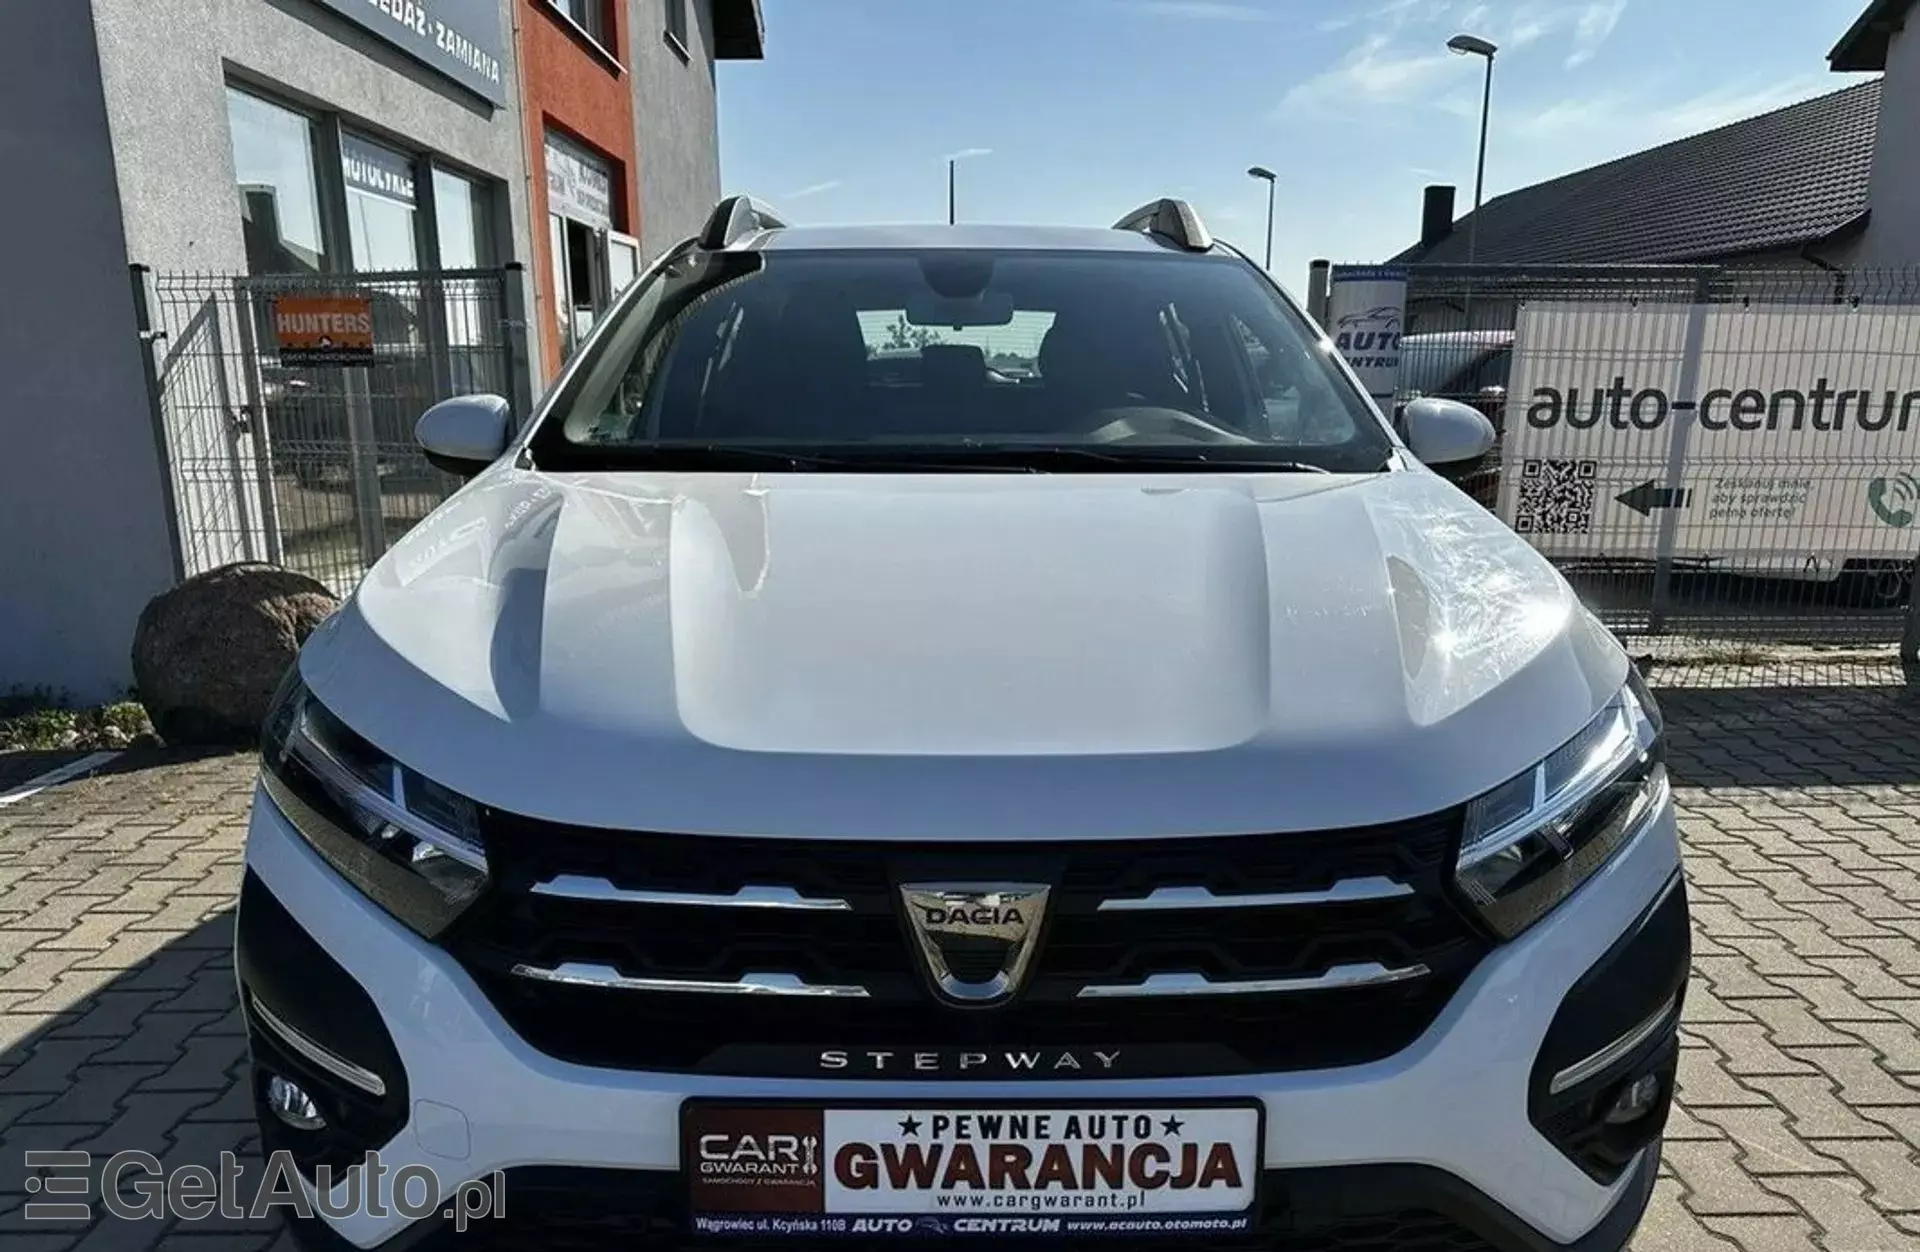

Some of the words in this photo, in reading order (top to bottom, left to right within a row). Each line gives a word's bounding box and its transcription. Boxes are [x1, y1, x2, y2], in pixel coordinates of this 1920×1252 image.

[435, 20, 500, 85] ZAMIANA
[278, 313, 370, 334] HUNTERS
[1711, 493, 1736, 505] aby
[819, 1050, 1121, 1070] STEPWAY
[932, 1115, 1051, 1140] PEWNE
[1064, 1114, 1152, 1139] AUTO
[700, 1134, 800, 1161] CAR
[700, 1161, 800, 1175] GWARANT
[834, 1142, 1243, 1191] GWARANCJA
[937, 1190, 1146, 1211] www.cargwarant.pl
[695, 1217, 754, 1232] Wągrowiec
[757, 1218, 769, 1231] ul.
[773, 1217, 818, 1234] Kcyńska
[852, 1218, 913, 1232] AUTO
[954, 1218, 1061, 1232] CENTRUM
[1067, 1218, 1248, 1232] www.acauto.otomoto.pl
